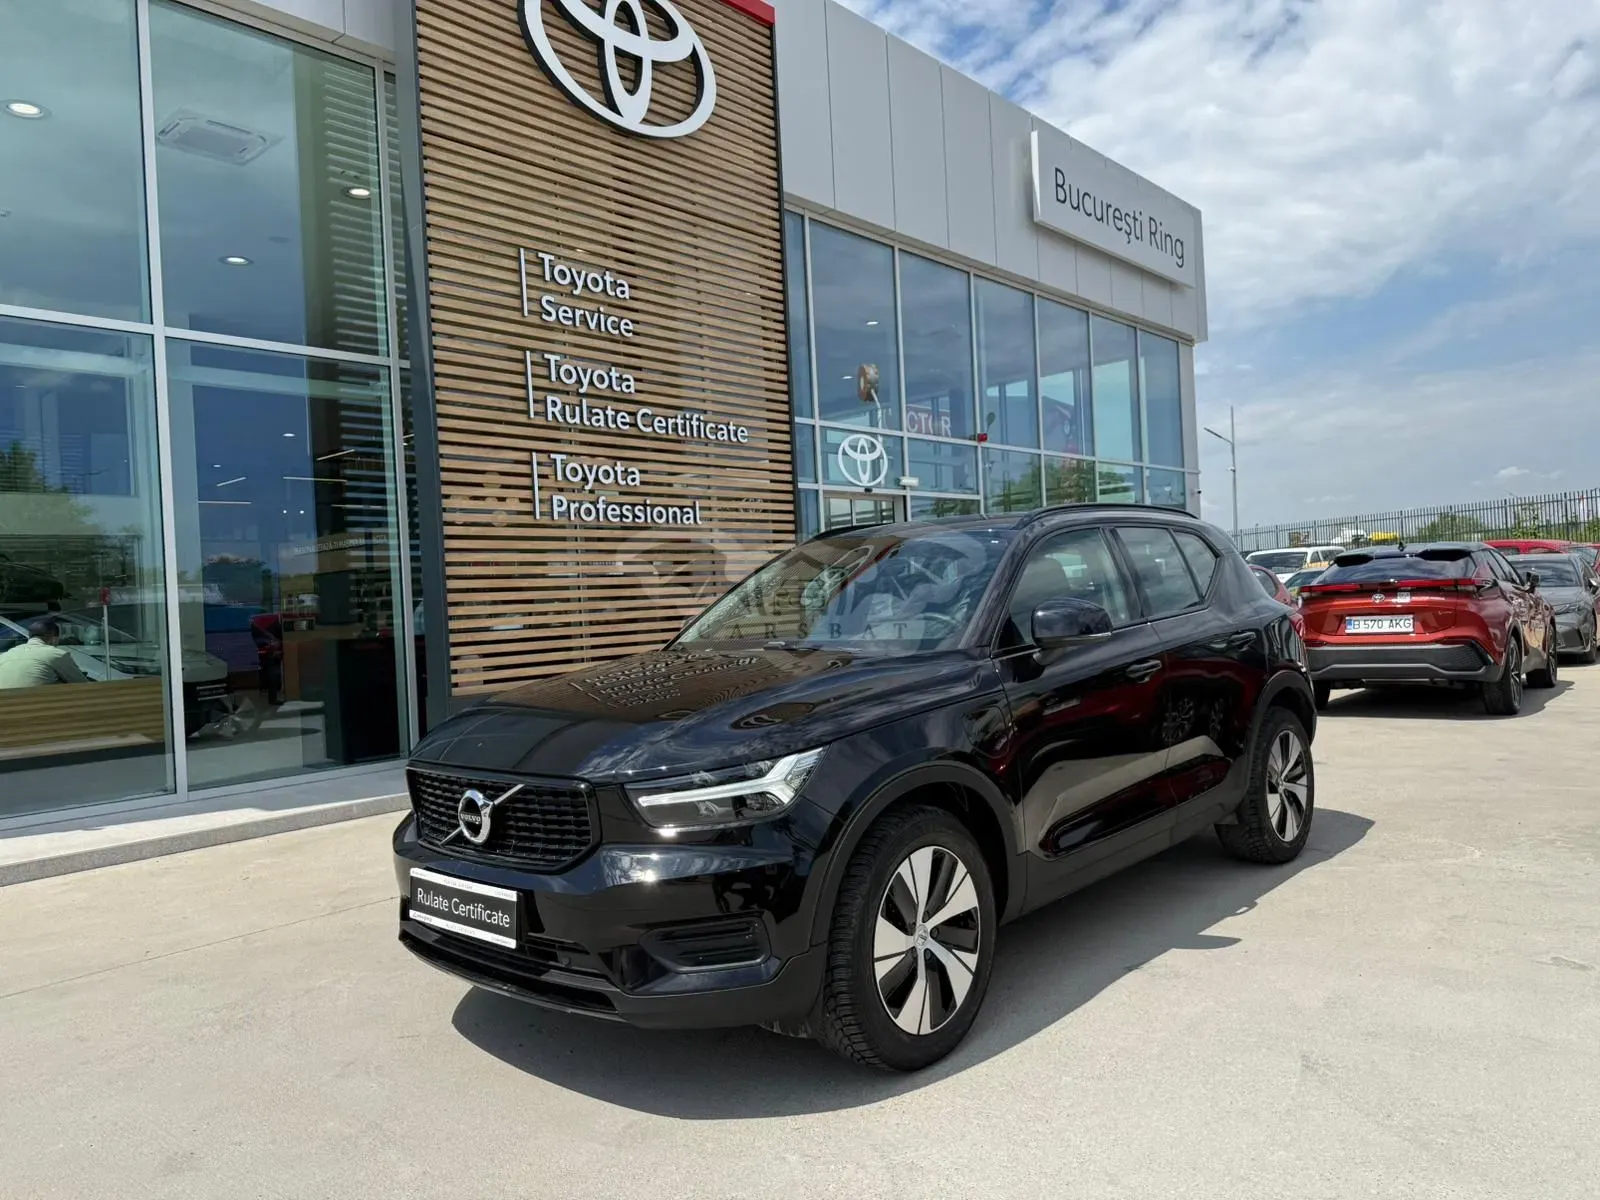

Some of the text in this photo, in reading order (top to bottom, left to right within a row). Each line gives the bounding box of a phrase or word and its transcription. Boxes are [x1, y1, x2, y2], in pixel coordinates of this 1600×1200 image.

[1148, 215, 1185, 269] Ring
[537, 252, 631, 300] Toyota
[540, 295, 634, 338] Service
[543, 353, 636, 394] Toyota
[545, 395, 749, 444] Rulate Certificate
[550, 453, 641, 490] Toyota
[551, 494, 703, 525] Professional
[1352, 618, 1412, 630] B 570 AKG
[416, 887, 450, 912] Rulate
[451, 897, 511, 928] Certificate
